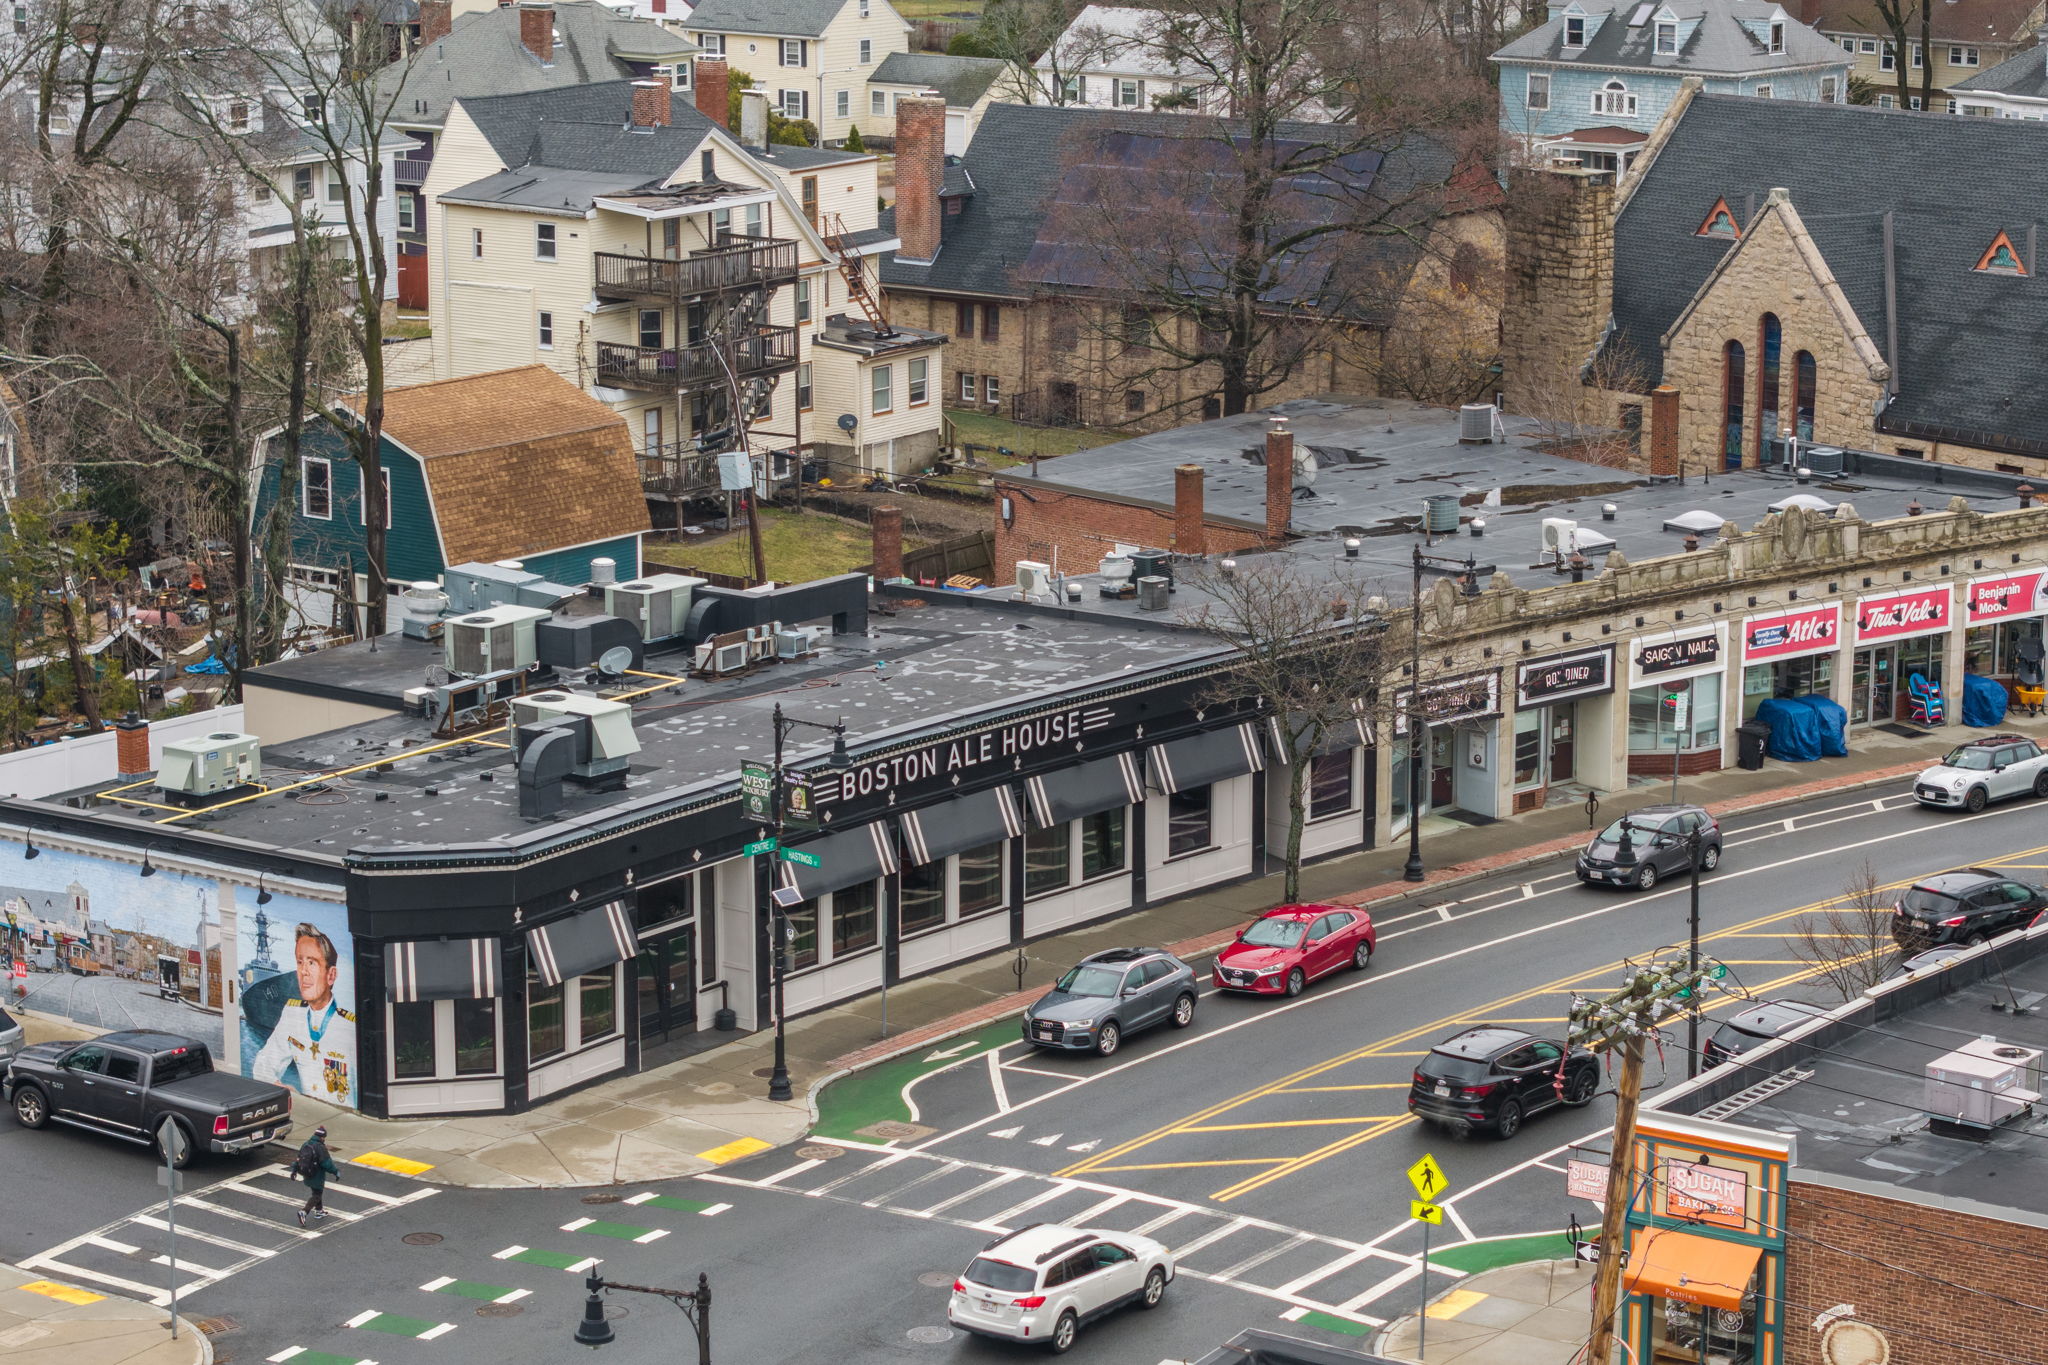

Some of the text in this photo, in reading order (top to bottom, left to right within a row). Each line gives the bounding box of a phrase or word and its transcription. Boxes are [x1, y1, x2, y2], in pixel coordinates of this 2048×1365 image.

[1979, 582, 2021, 601] Benjamin
[1565, 666, 1590, 681] DINER
[841, 710, 1081, 801] BOSTON ALE HOUSE
[742, 774, 772, 790] WEST
[751, 840, 770, 854] CENTRE
[787, 850, 813, 865] HASTINGS
[242, 1103, 279, 1121] RAM
[1676, 1168, 1736, 1200] SUGAR
[1665, 1287, 1698, 1301] Pastries
